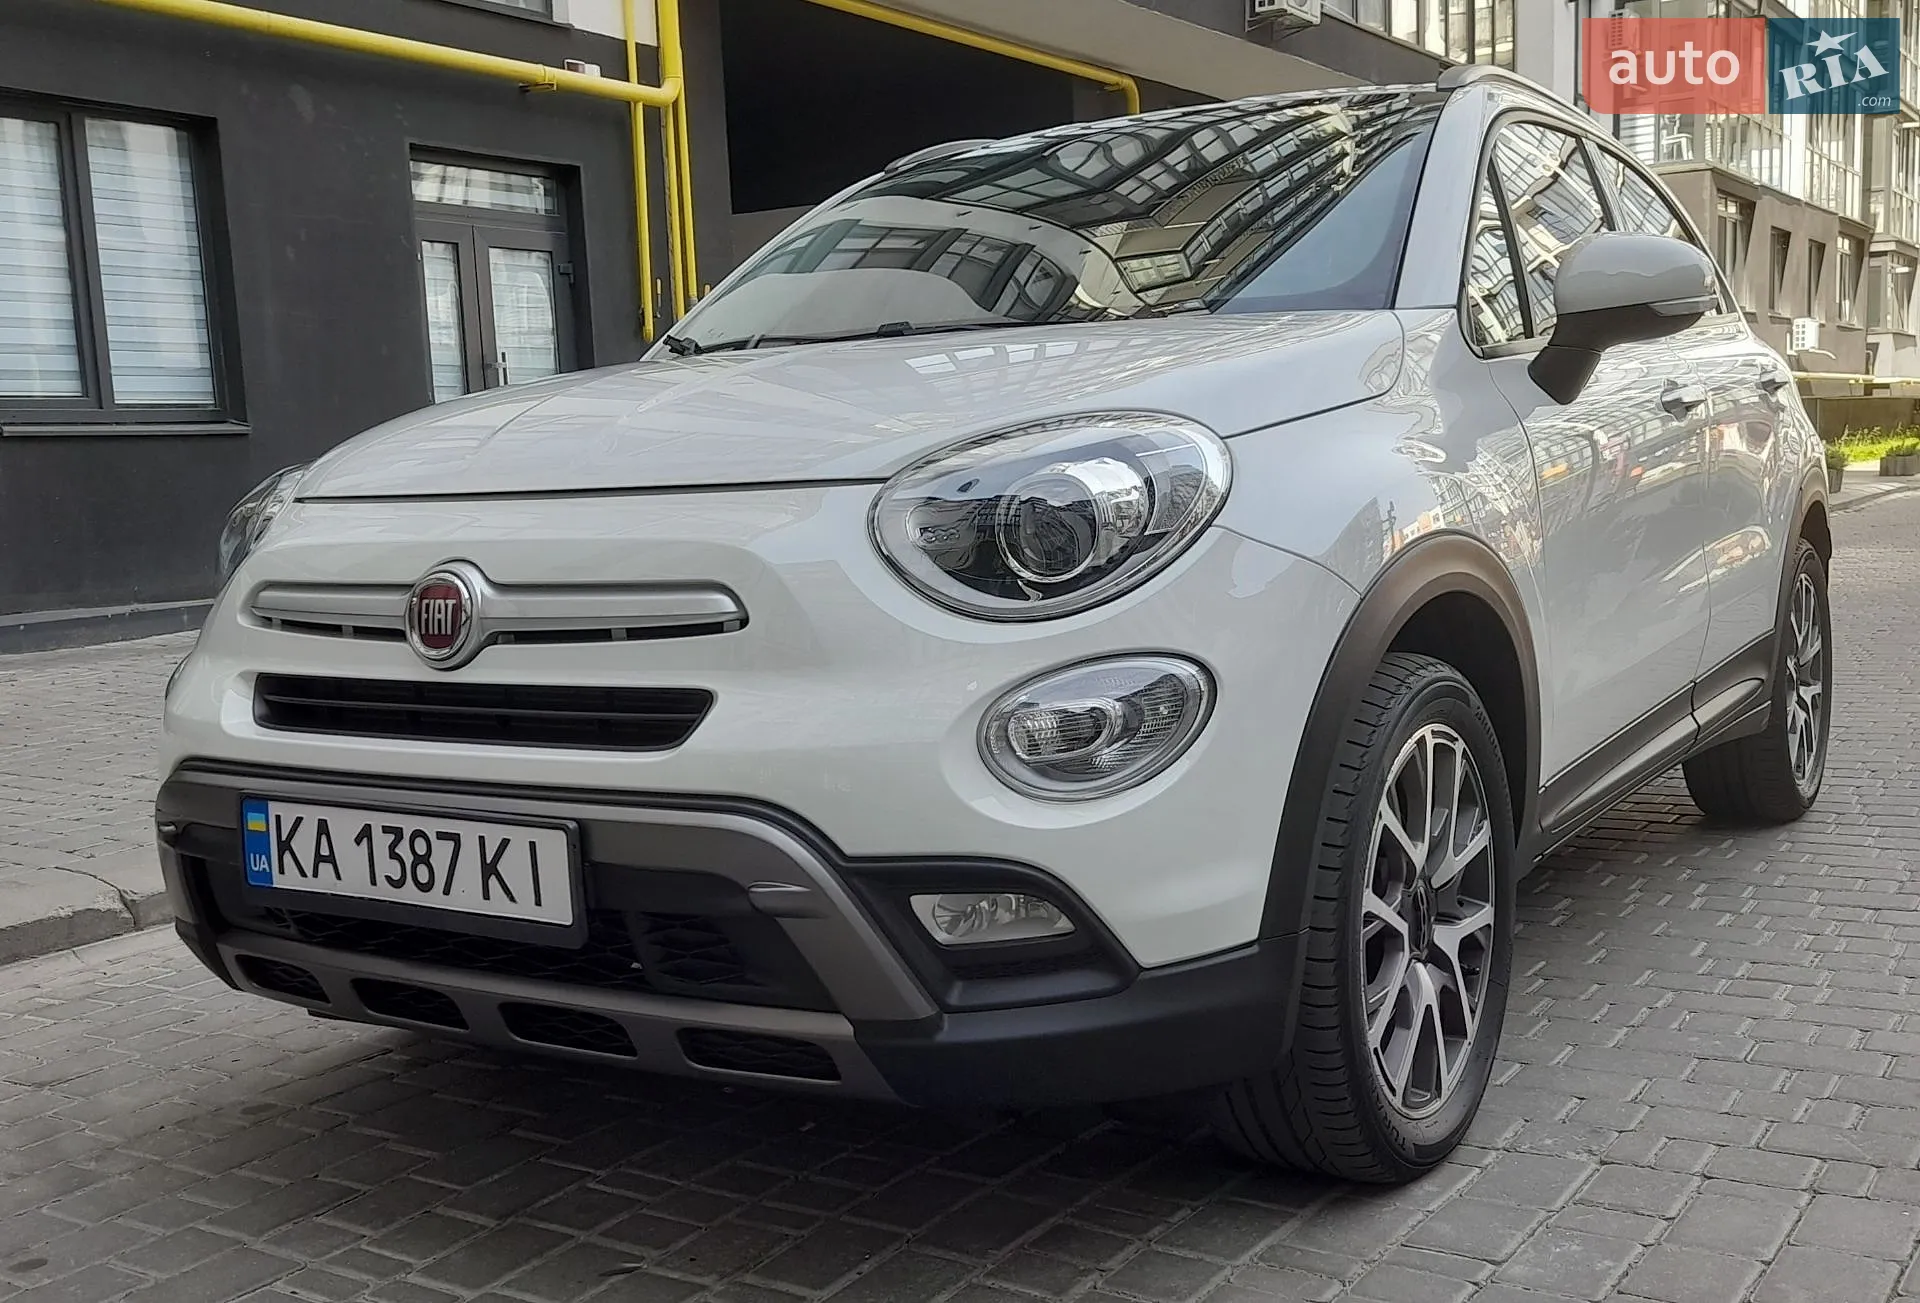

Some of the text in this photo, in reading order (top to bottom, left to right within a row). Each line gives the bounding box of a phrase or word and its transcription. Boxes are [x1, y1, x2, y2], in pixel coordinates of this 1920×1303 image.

[421, 599, 456, 635] FIAT
[250, 853, 270, 873] UA
[275, 814, 342, 881] KA
[354, 823, 461, 896] 1387
